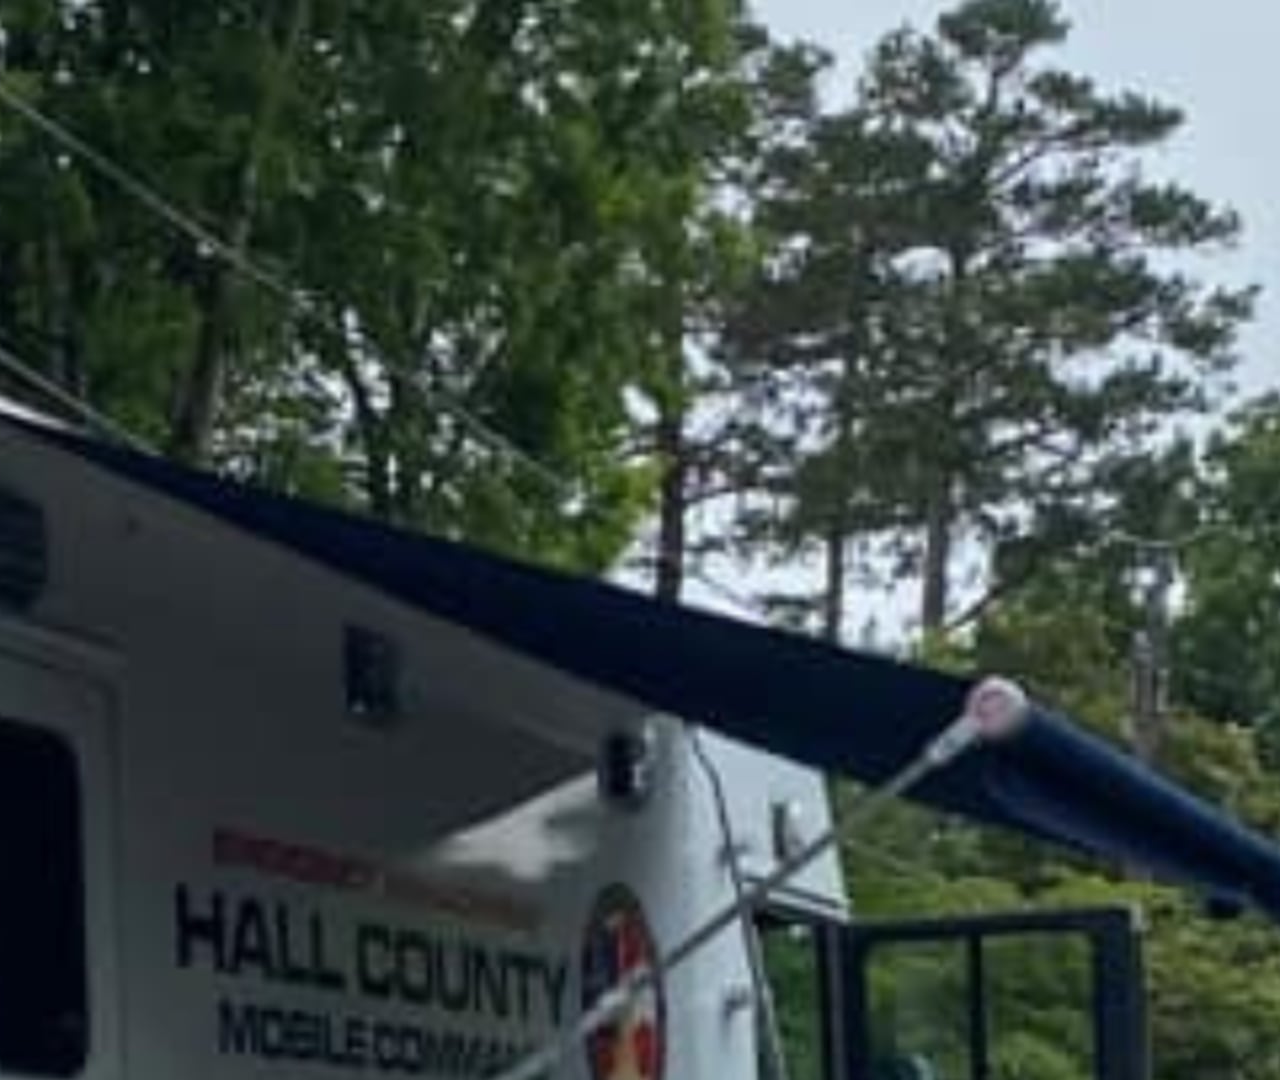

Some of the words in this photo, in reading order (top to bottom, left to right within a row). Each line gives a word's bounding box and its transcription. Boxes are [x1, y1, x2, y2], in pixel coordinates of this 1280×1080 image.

[174, 880, 347, 990] HALL
[355, 921, 568, 1028] COUNTY
[216, 998, 370, 1067] MOBILE
